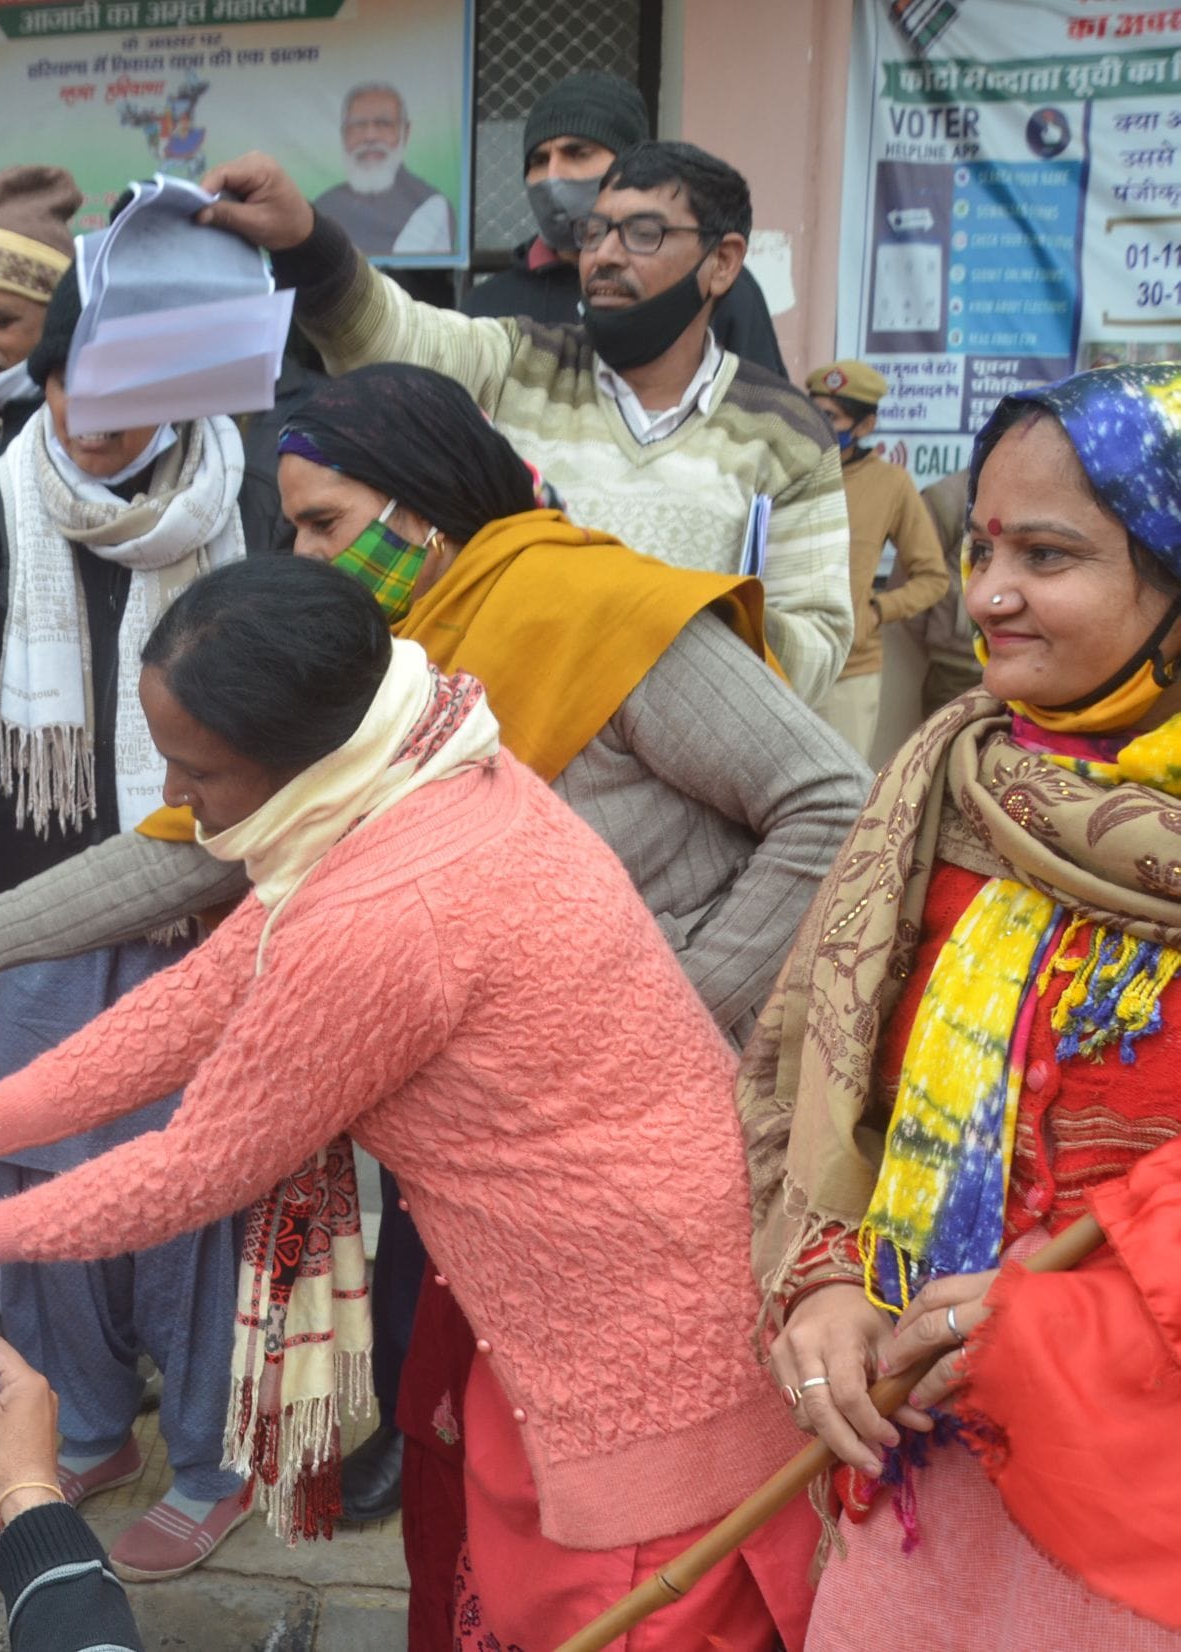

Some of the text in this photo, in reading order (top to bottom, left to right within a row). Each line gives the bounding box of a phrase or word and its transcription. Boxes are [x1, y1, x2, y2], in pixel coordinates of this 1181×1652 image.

[106, 4, 138, 27] का
[1067, 15, 1110, 41] का
[1065, 56, 1124, 98] सूची
[1127, 59, 1169, 85] का
[889, 105, 980, 139] VOTER
[1113, 112, 1161, 133] क्या
[885, 142, 980, 161] HELPLINE APP
